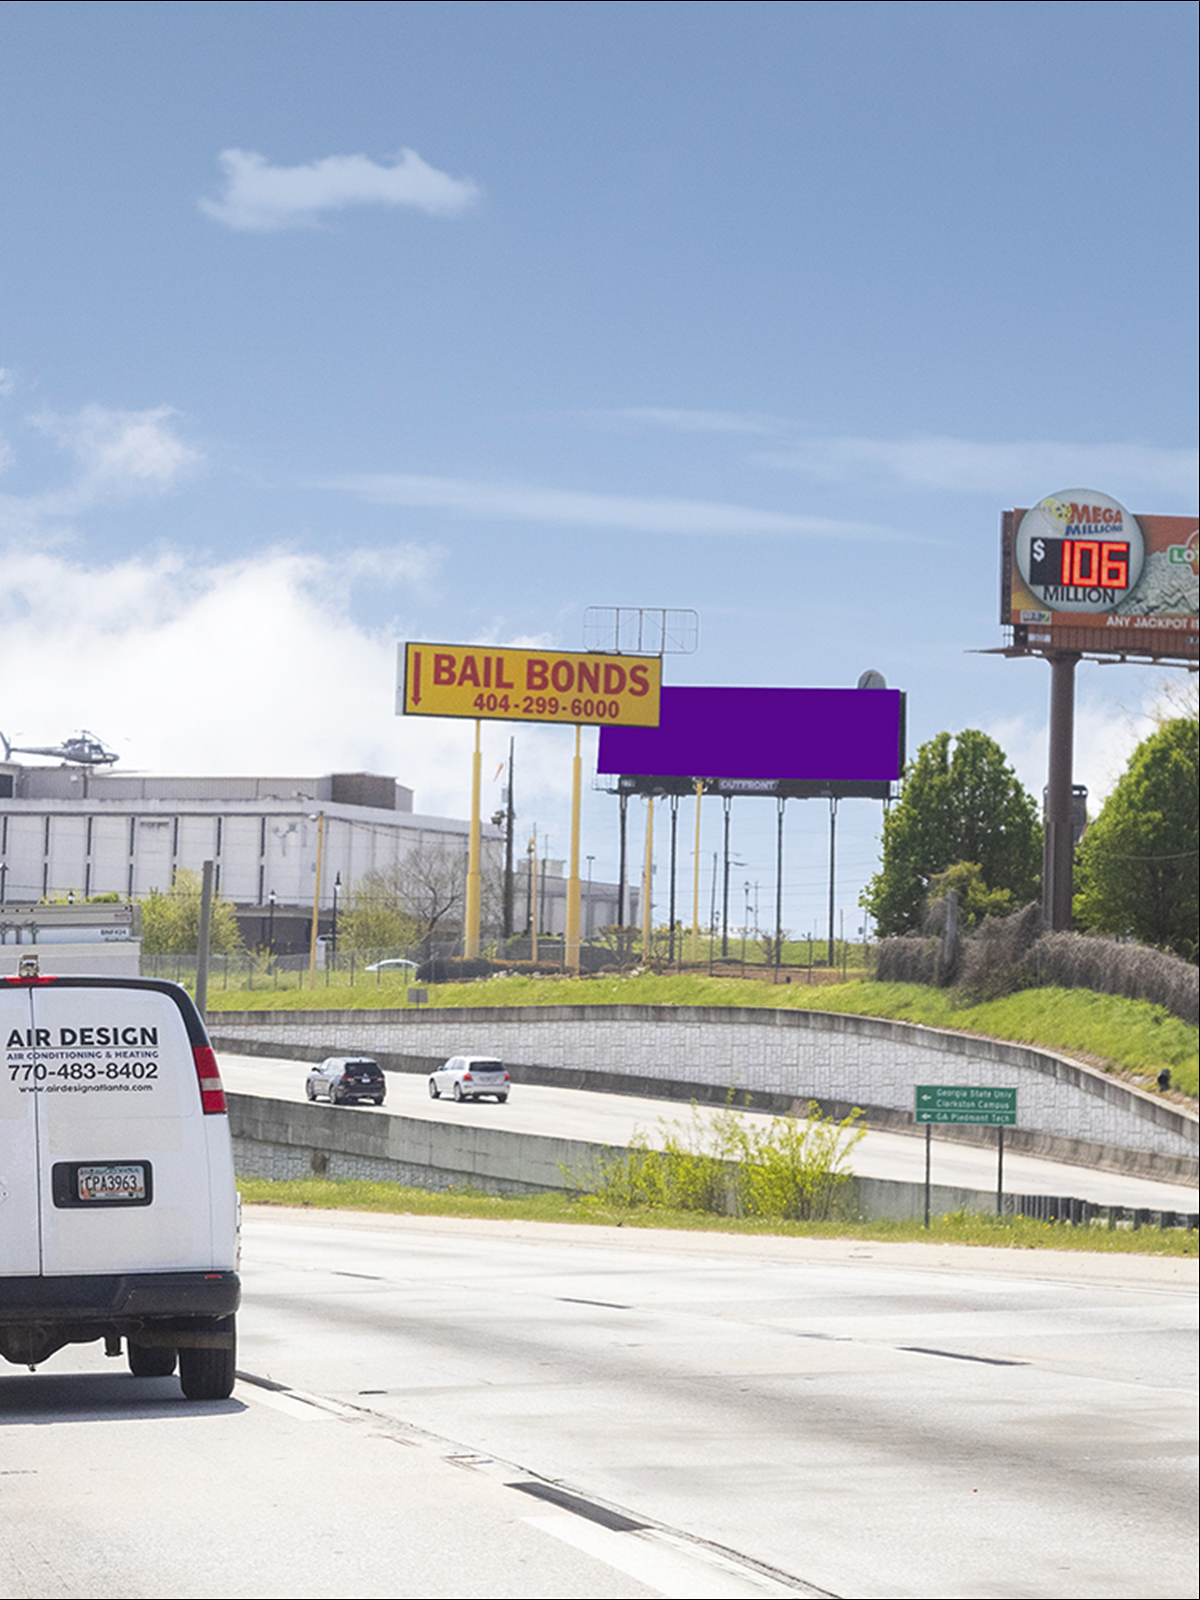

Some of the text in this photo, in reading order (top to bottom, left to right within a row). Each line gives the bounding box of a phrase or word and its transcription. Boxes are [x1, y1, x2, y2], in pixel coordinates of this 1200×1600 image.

[1067, 502, 1123, 524] MEGA
[1065, 524, 1123, 536] MILLIONS
[1173, 549, 1199, 563] LO
[1032, 539, 1128, 589] $ 106
[1044, 586, 1115, 604] MILLION
[1106, 616, 1131, 627] ANY
[1133, 617, 1188, 630] JACKPOT
[433, 653, 650, 697] BAIL BONDS
[473, 693, 620, 719] 404-299-6000
[720, 780, 777, 790] OUTFRONT
[6, 1026, 158, 1047] AIR DESIGN
[6, 1052, 24, 1061] AIR
[26, 1051, 103, 1060] CONDITIONING
[114, 1050, 159, 1059] HEATING
[8, 1062, 159, 1081] 770-483-8402
[18, 1083, 153, 1094] www.airdesignatlanta.com
[936, 1088, 967, 1099] Georgia
[970, 1089, 991, 1098] State
[978, 1100, 1009, 1110] Campus
[992, 1114, 1010, 1123] Tech
[85, 1174, 137, 1191] CPA3963
